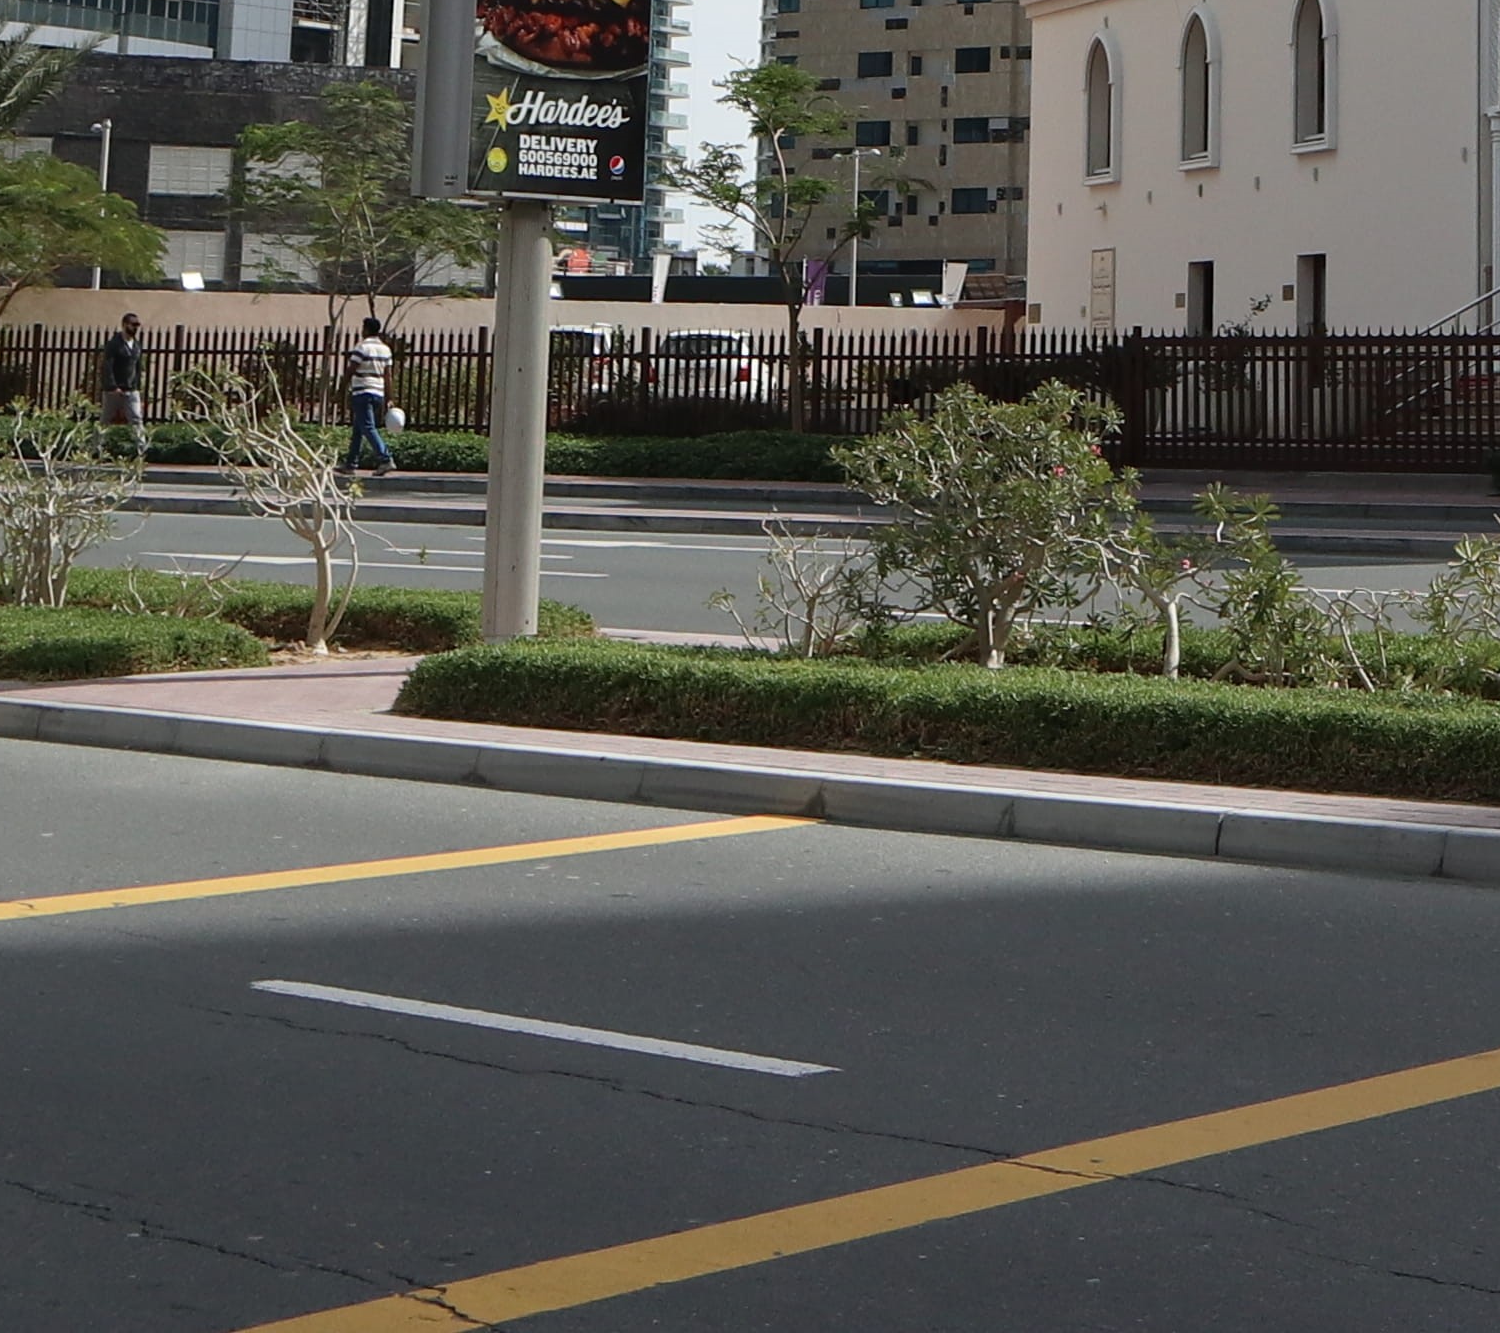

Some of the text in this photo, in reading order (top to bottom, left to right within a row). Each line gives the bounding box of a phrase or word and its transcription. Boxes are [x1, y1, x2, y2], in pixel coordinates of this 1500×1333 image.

[505, 89, 631, 129] Hardee's
[519, 134, 598, 154] DELIVERY
[518, 149, 598, 167] 600569000
[518, 163, 598, 180] HARDEES.AE
